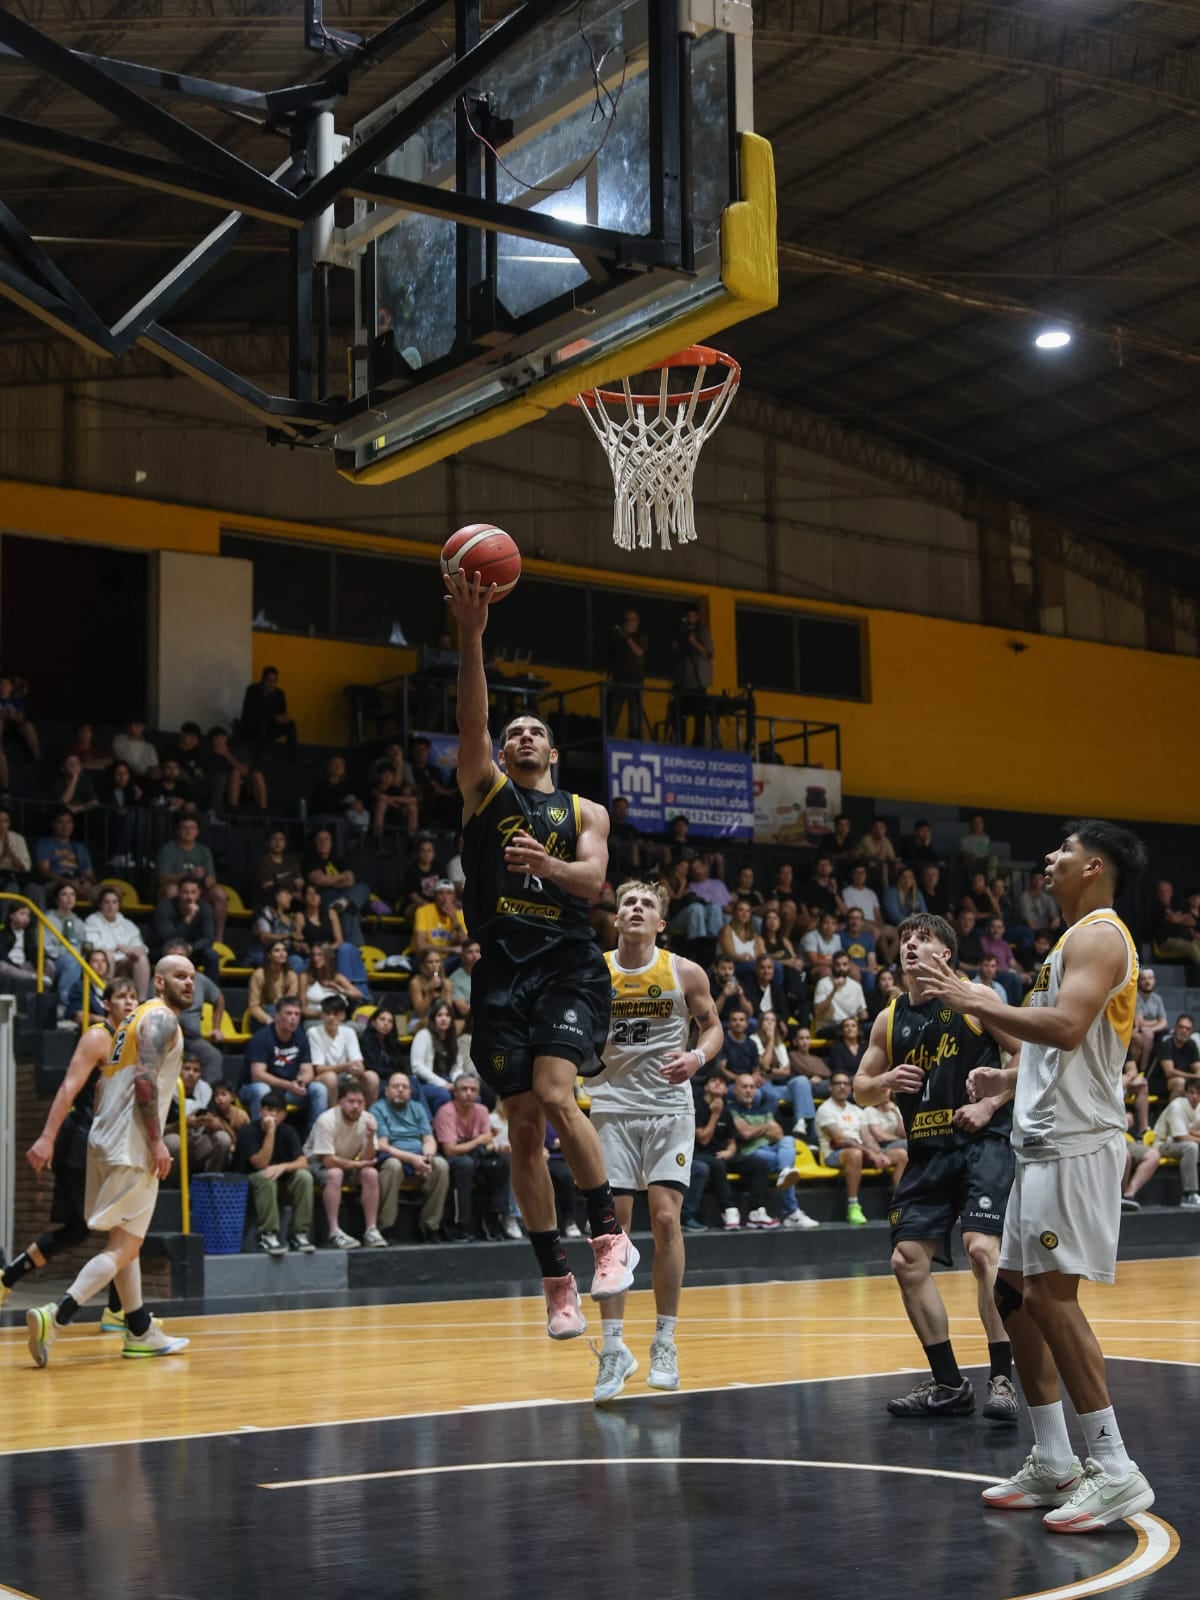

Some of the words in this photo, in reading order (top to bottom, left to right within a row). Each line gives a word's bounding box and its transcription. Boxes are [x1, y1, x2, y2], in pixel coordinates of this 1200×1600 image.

[664, 756, 706, 770] SERVICIO
[664, 772, 693, 785] VENTA
[694, 775, 707, 787] DE
[708, 777, 748, 791] EQUIPOS
[611, 999, 673, 1017] UNICACIONES
[612, 1019, 650, 1046] 22
[914, 1111, 950, 1128] ULCOR
